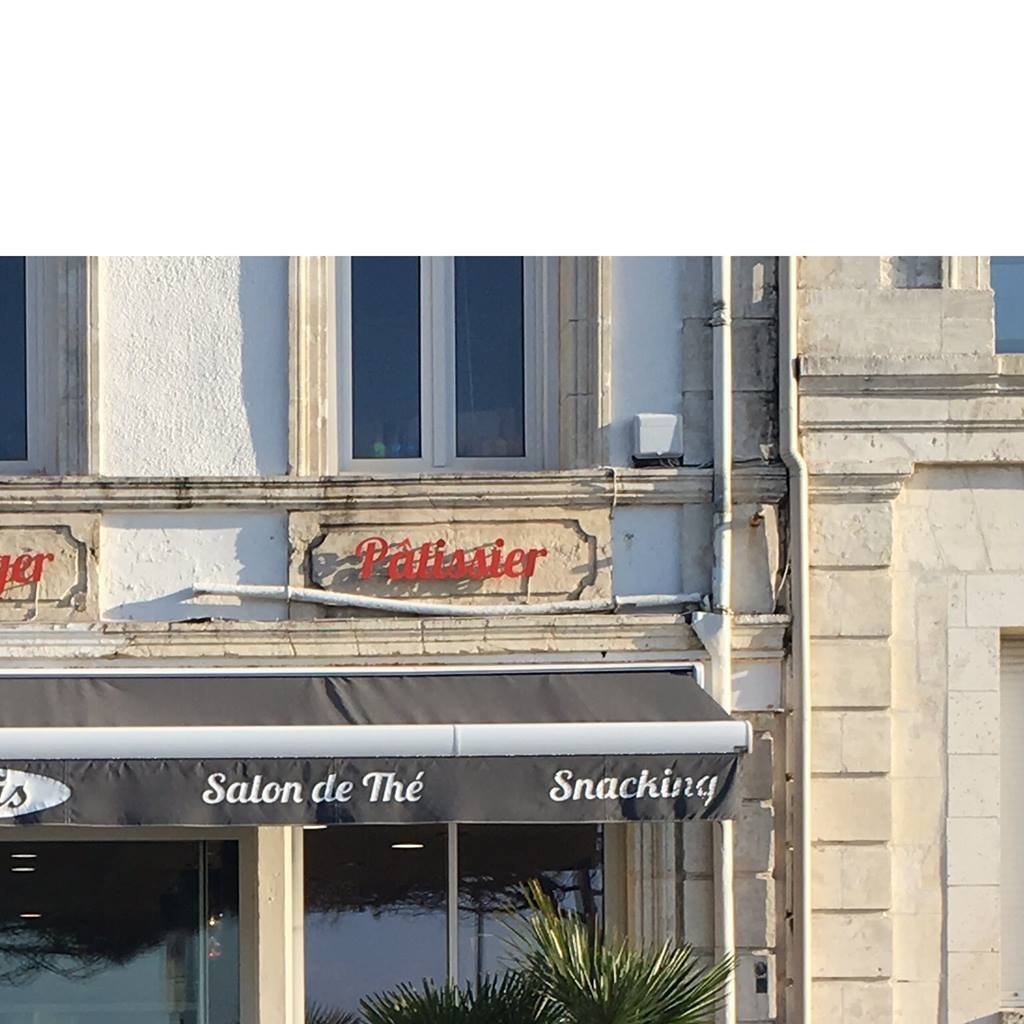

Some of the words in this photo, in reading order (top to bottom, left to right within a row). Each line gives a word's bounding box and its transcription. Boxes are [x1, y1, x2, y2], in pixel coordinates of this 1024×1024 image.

[355, 536, 549, 581] Pâtissier
[202, 772, 304, 805] Salon
[311, 773, 355, 803] de
[362, 770, 425, 803] Thé
[549, 768, 719, 807] Snacking
